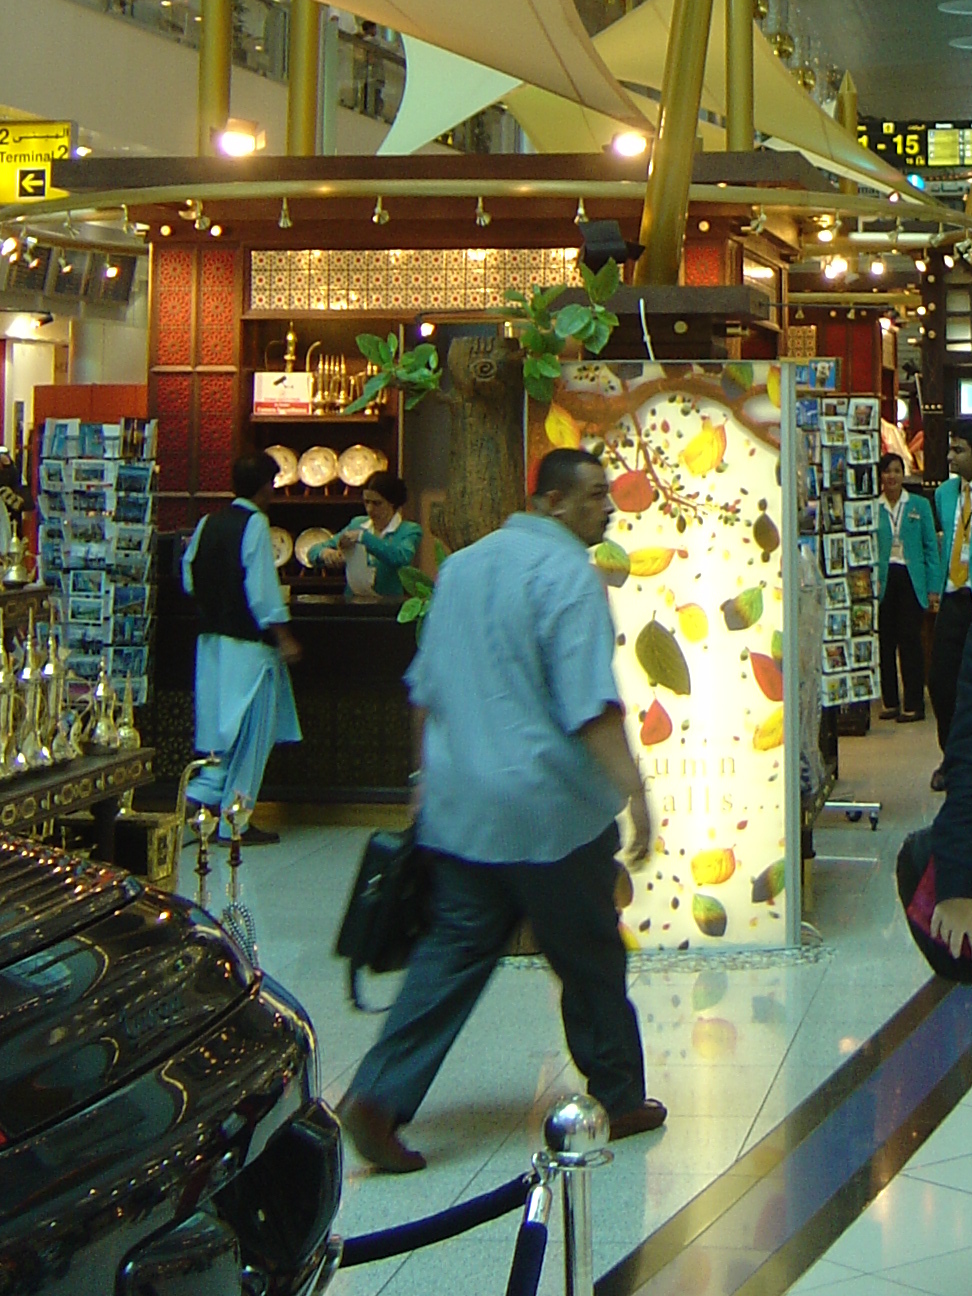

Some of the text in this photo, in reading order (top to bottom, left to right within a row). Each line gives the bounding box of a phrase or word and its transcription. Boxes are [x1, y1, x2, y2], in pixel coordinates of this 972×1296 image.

[0, 128, 9, 144] 2
[892, 134, 920, 155] 15
[0, 145, 68, 163] Terminal 2
